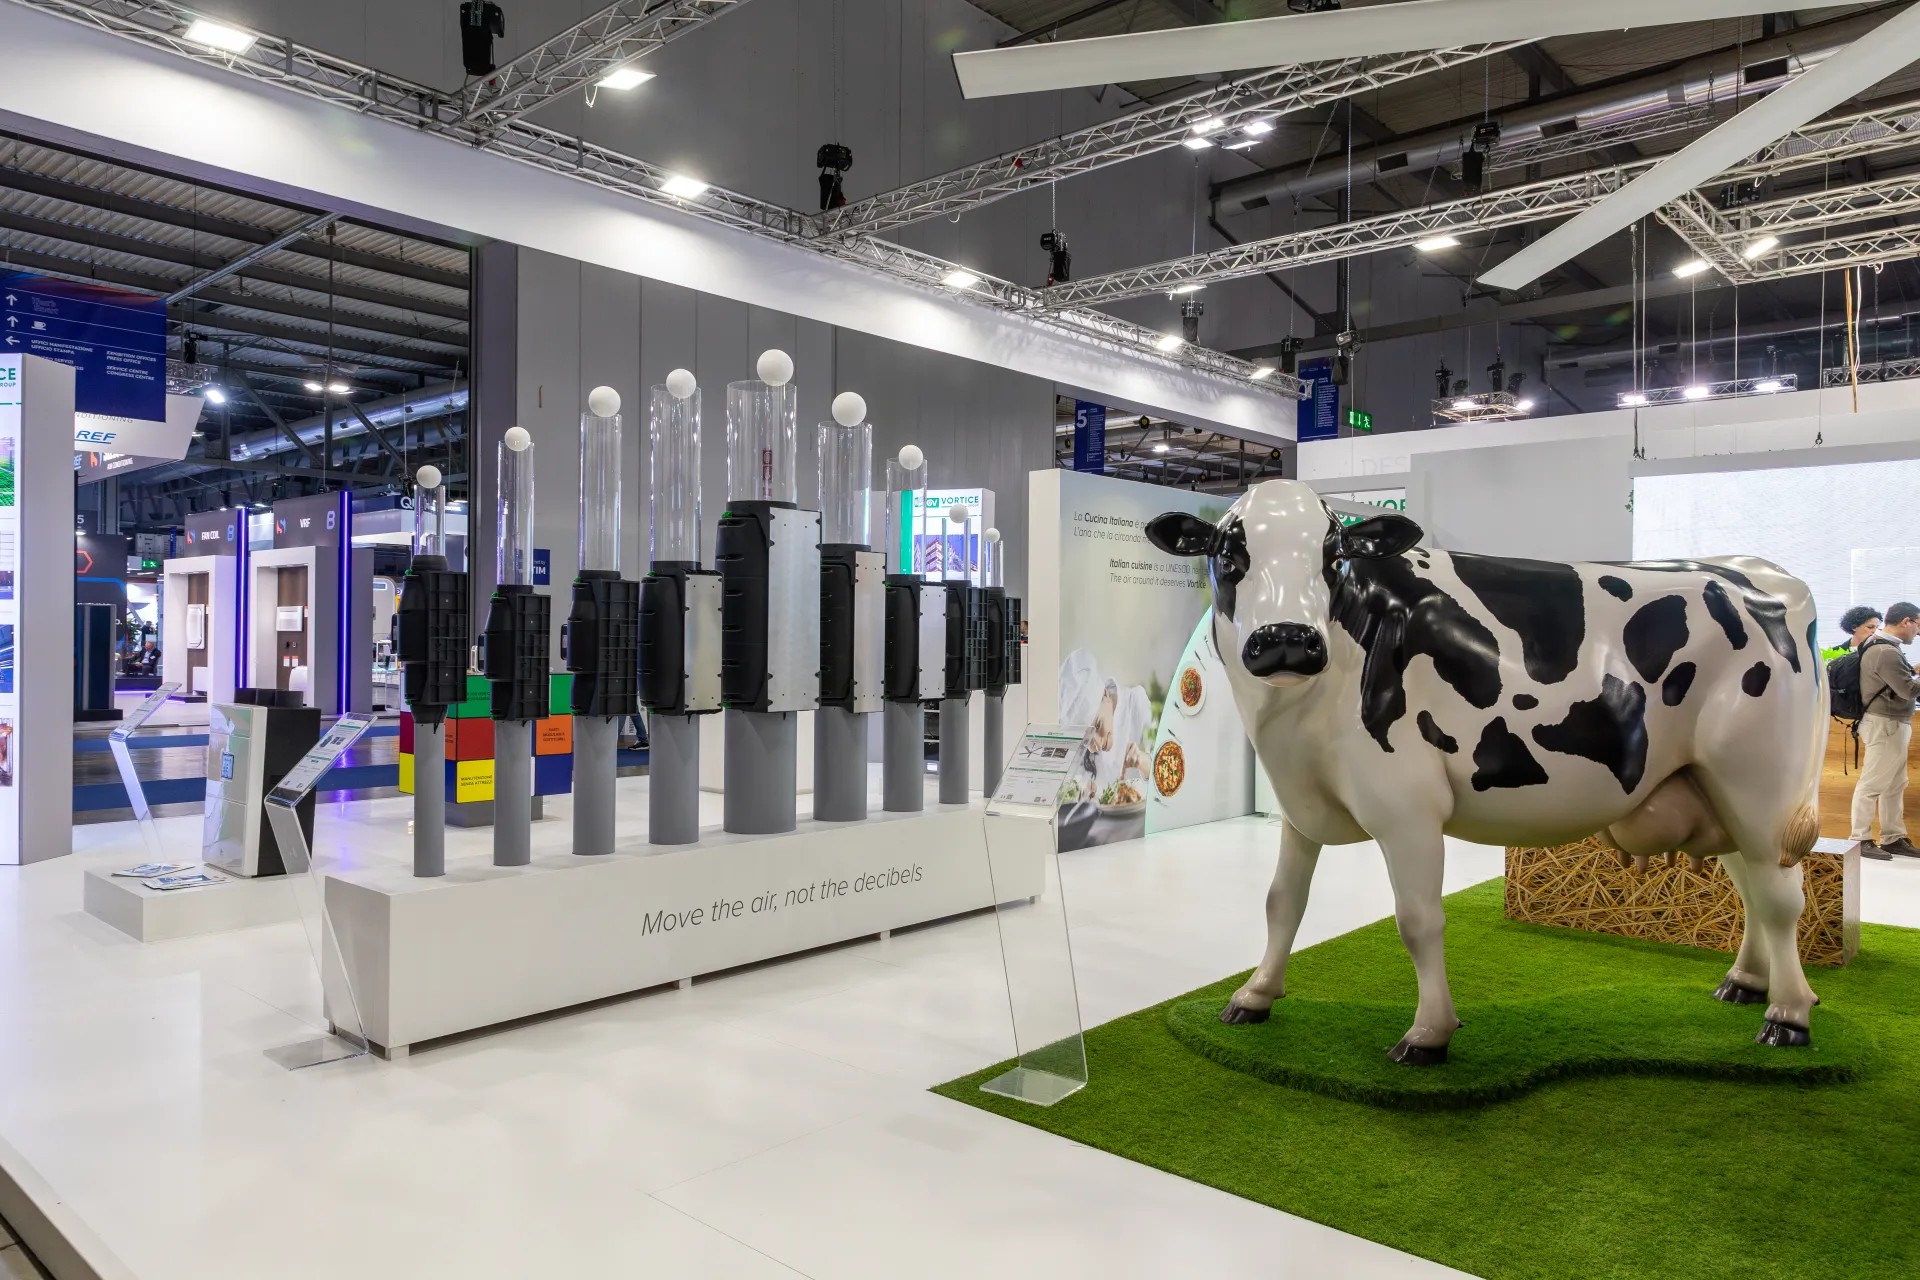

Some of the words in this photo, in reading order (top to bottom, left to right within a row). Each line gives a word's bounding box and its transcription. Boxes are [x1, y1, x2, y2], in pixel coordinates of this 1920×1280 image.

[1076, 409, 1087, 428] 5
[941, 496, 979, 504] VORTICE
[1074, 511, 1083, 521] La
[1084, 512, 1108, 524] Cucina
[1109, 516, 1134, 527] Italiana
[1093, 529, 1106, 539] che
[1107, 530, 1114, 540] la
[1114, 532, 1141, 542] circonda
[1109, 558, 1130, 569] Italian
[1131, 561, 1153, 571] cuisine
[1154, 563, 1158, 572] is
[1110, 573, 1122, 583] The
[1123, 575, 1131, 584] air
[1132, 575, 1154, 585] around
[1155, 576, 1159, 586] it
[1160, 577, 1186, 588] deserves
[1187, 579, 1207, 589] Vortice
[641, 907, 704, 936] Move
[711, 898, 744, 922] the
[751, 890, 778, 913] air,
[784, 882, 816, 907] not
[820, 878, 849, 900] the
[854, 863, 923, 893] decibels
